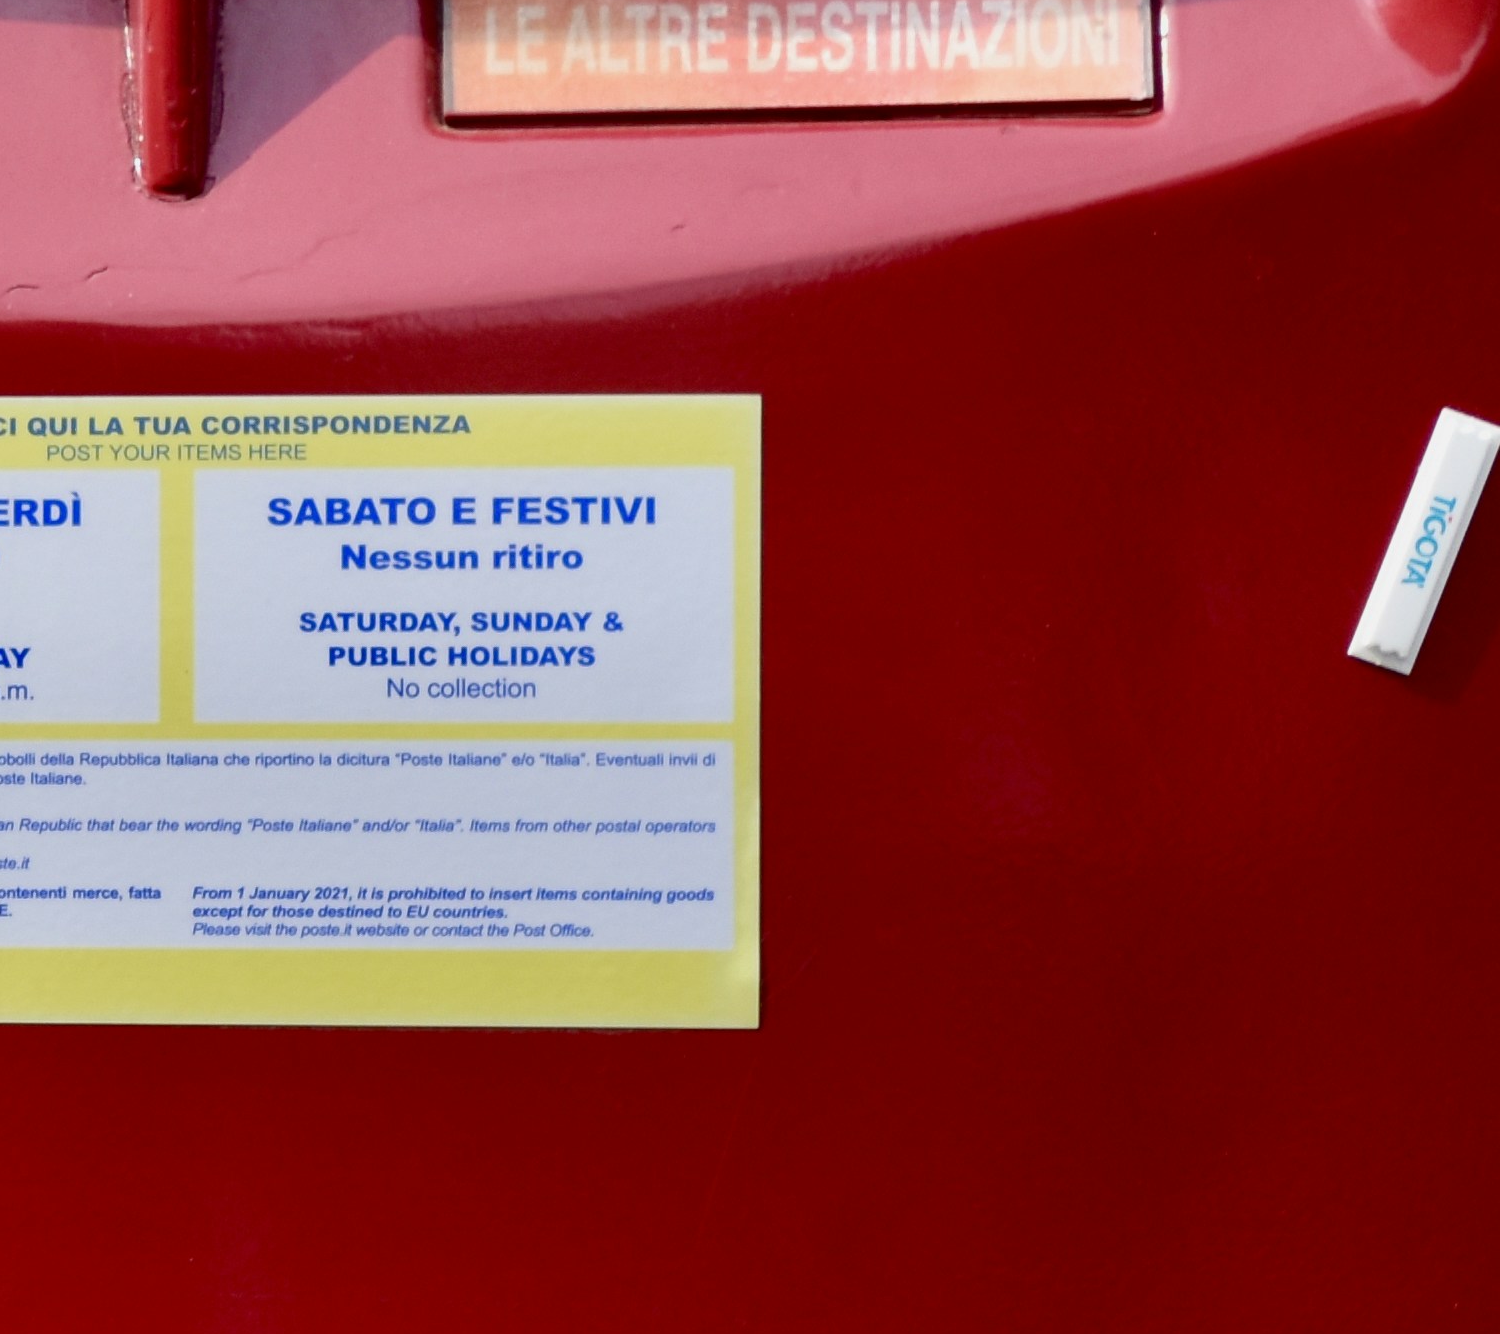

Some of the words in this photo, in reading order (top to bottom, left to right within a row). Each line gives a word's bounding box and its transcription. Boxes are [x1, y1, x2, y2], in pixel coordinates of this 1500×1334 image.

[482, 3, 557, 79] LE
[563, 0, 730, 76] ALTRE
[26, 416, 78, 438] QUI
[88, 416, 125, 437] LA
[132, 415, 192, 436] TUA
[200, 414, 472, 436] CORRISPONDENZA
[46, 443, 104, 462] POST
[108, 443, 171, 462] YOUR
[177, 443, 243, 462] ITEMS
[248, 442, 307, 461] HERE
[267, 496, 437, 527] SABATO
[451, 496, 477, 526] E
[491, 495, 656, 526] FESTIVI
[340, 543, 480, 571] Nessun
[492, 543, 584, 570] ritiro
[299, 611, 461, 637] SATURDAY,
[470, 611, 593, 633] SUNDAY
[602, 611, 624, 633] &
[328, 645, 438, 668] PUBLIC
[447, 645, 596, 667] HOLIDAYS
[386, 677, 421, 700] No
[427, 677, 537, 700] collection
[30, 771, 87, 786] Italiane.
[72, 888, 124, 902] merce,
[127, 885, 162, 900] fatta
